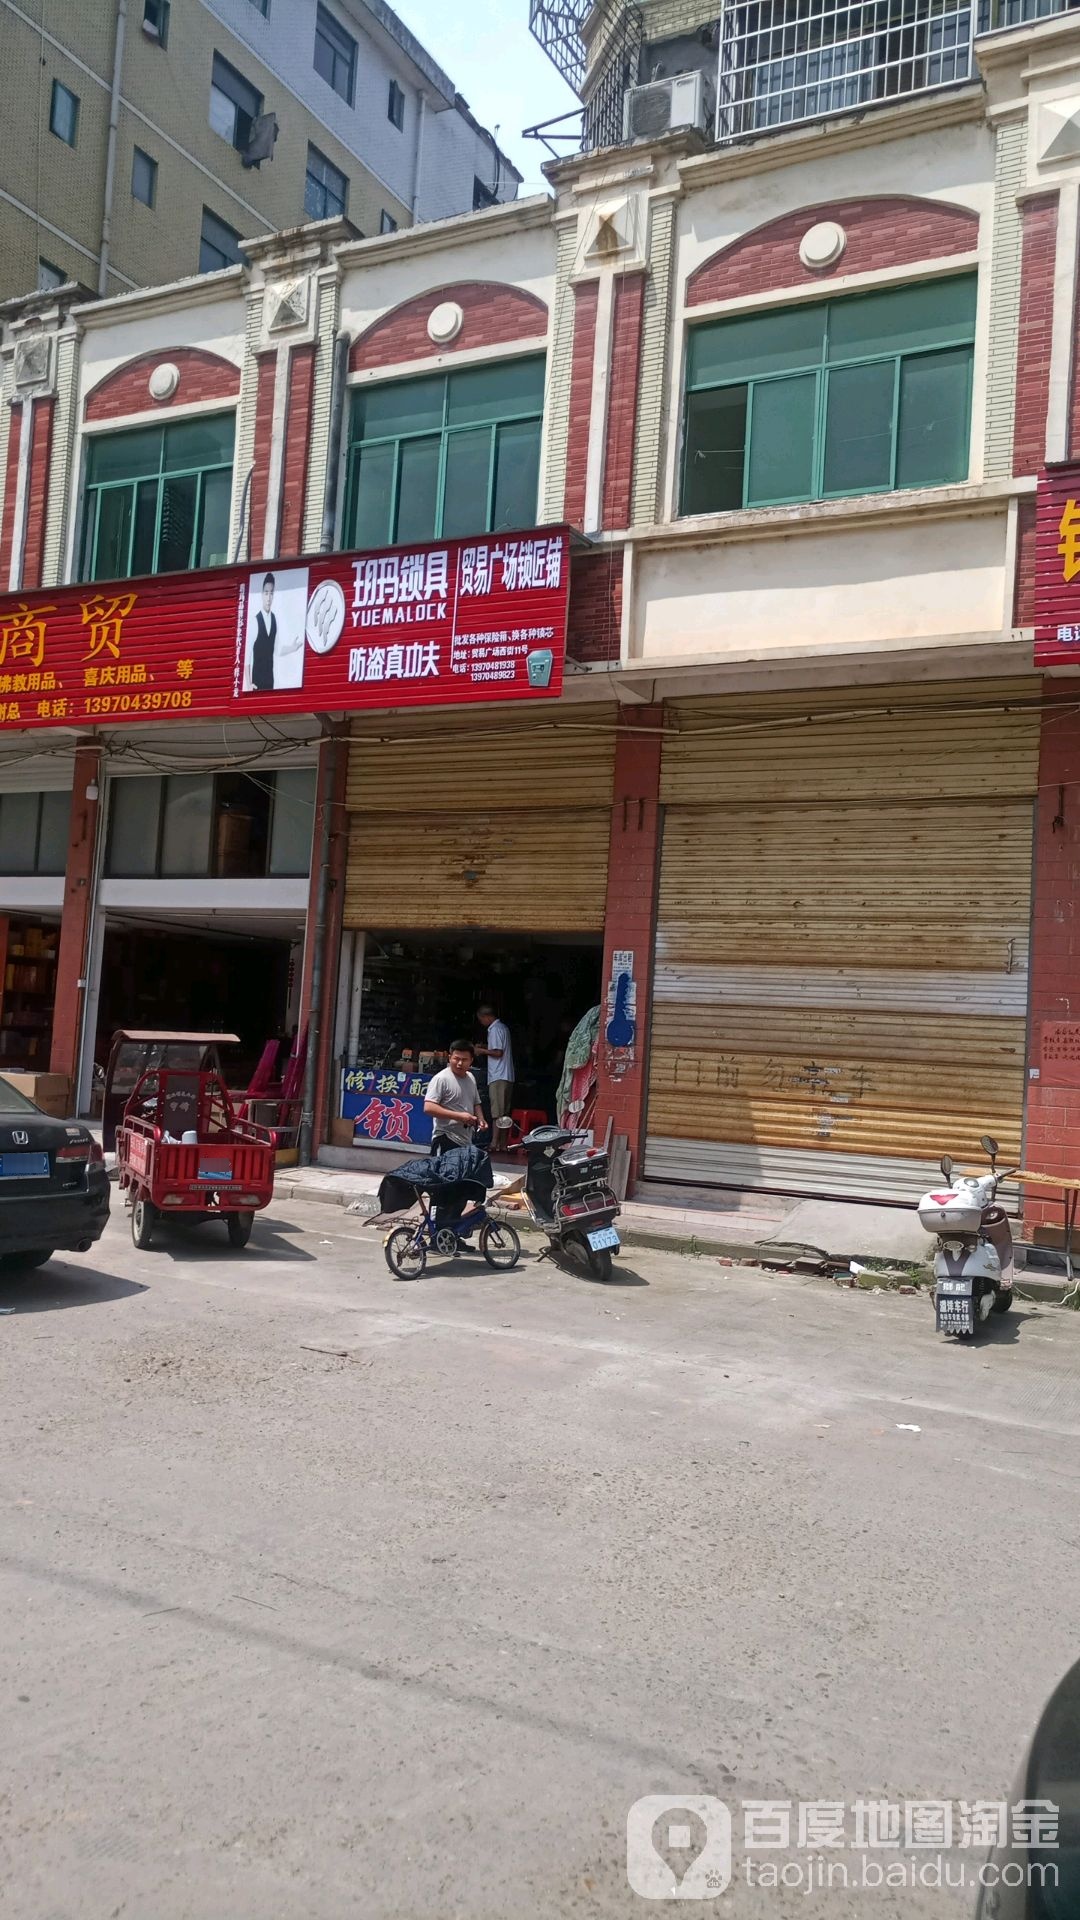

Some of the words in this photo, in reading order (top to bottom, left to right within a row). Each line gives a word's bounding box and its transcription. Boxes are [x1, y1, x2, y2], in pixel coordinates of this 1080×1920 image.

[351, 550, 449, 607] 玥玛锁具
[460, 537, 563, 596] 贸易广场锁匠铺
[0, 593, 138, 667] 商贸
[351, 603, 447, 627] YUEMALOCK
[177, 659, 194, 679] 等
[348, 641, 440, 682] 防盗真功夫
